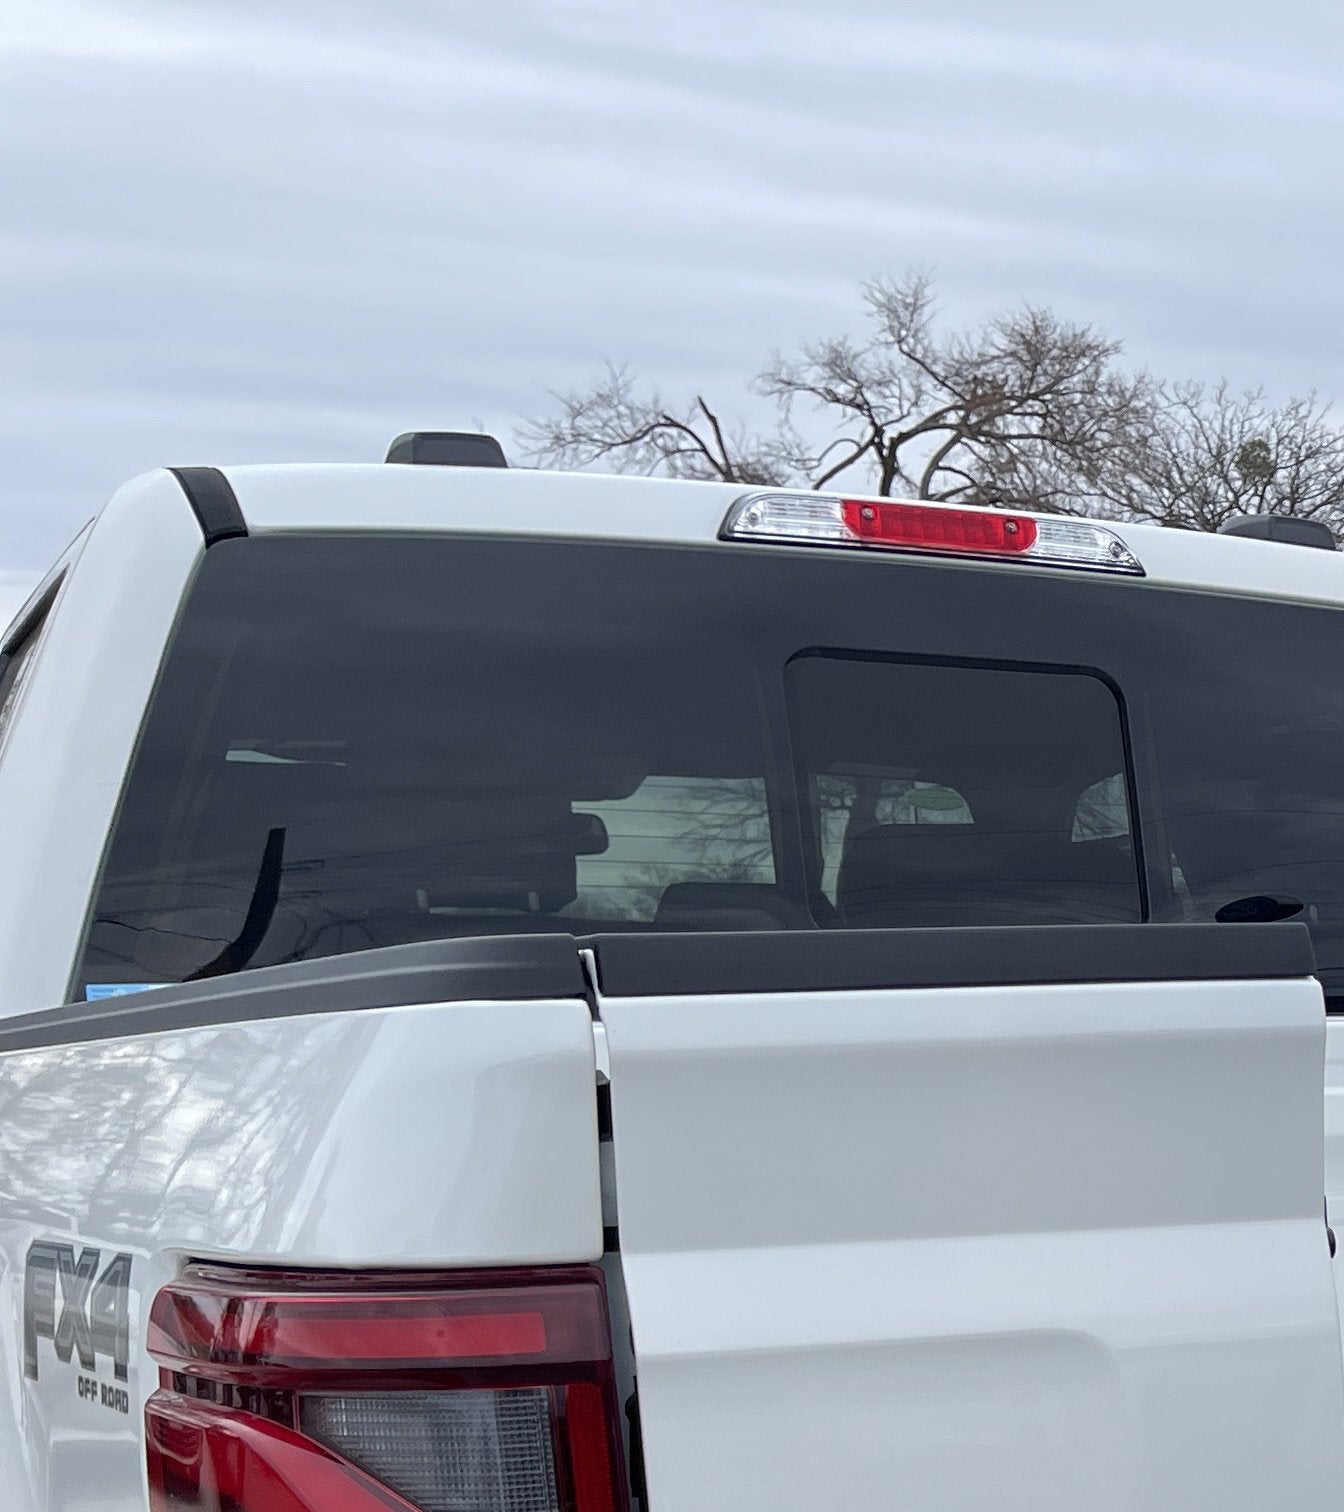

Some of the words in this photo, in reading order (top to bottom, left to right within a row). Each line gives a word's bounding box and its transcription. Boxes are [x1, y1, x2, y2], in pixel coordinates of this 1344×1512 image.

[24, 1240, 133, 1383] FX4
[78, 1376, 98, 1402] OFF
[101, 1383, 129, 1414] ROAD
